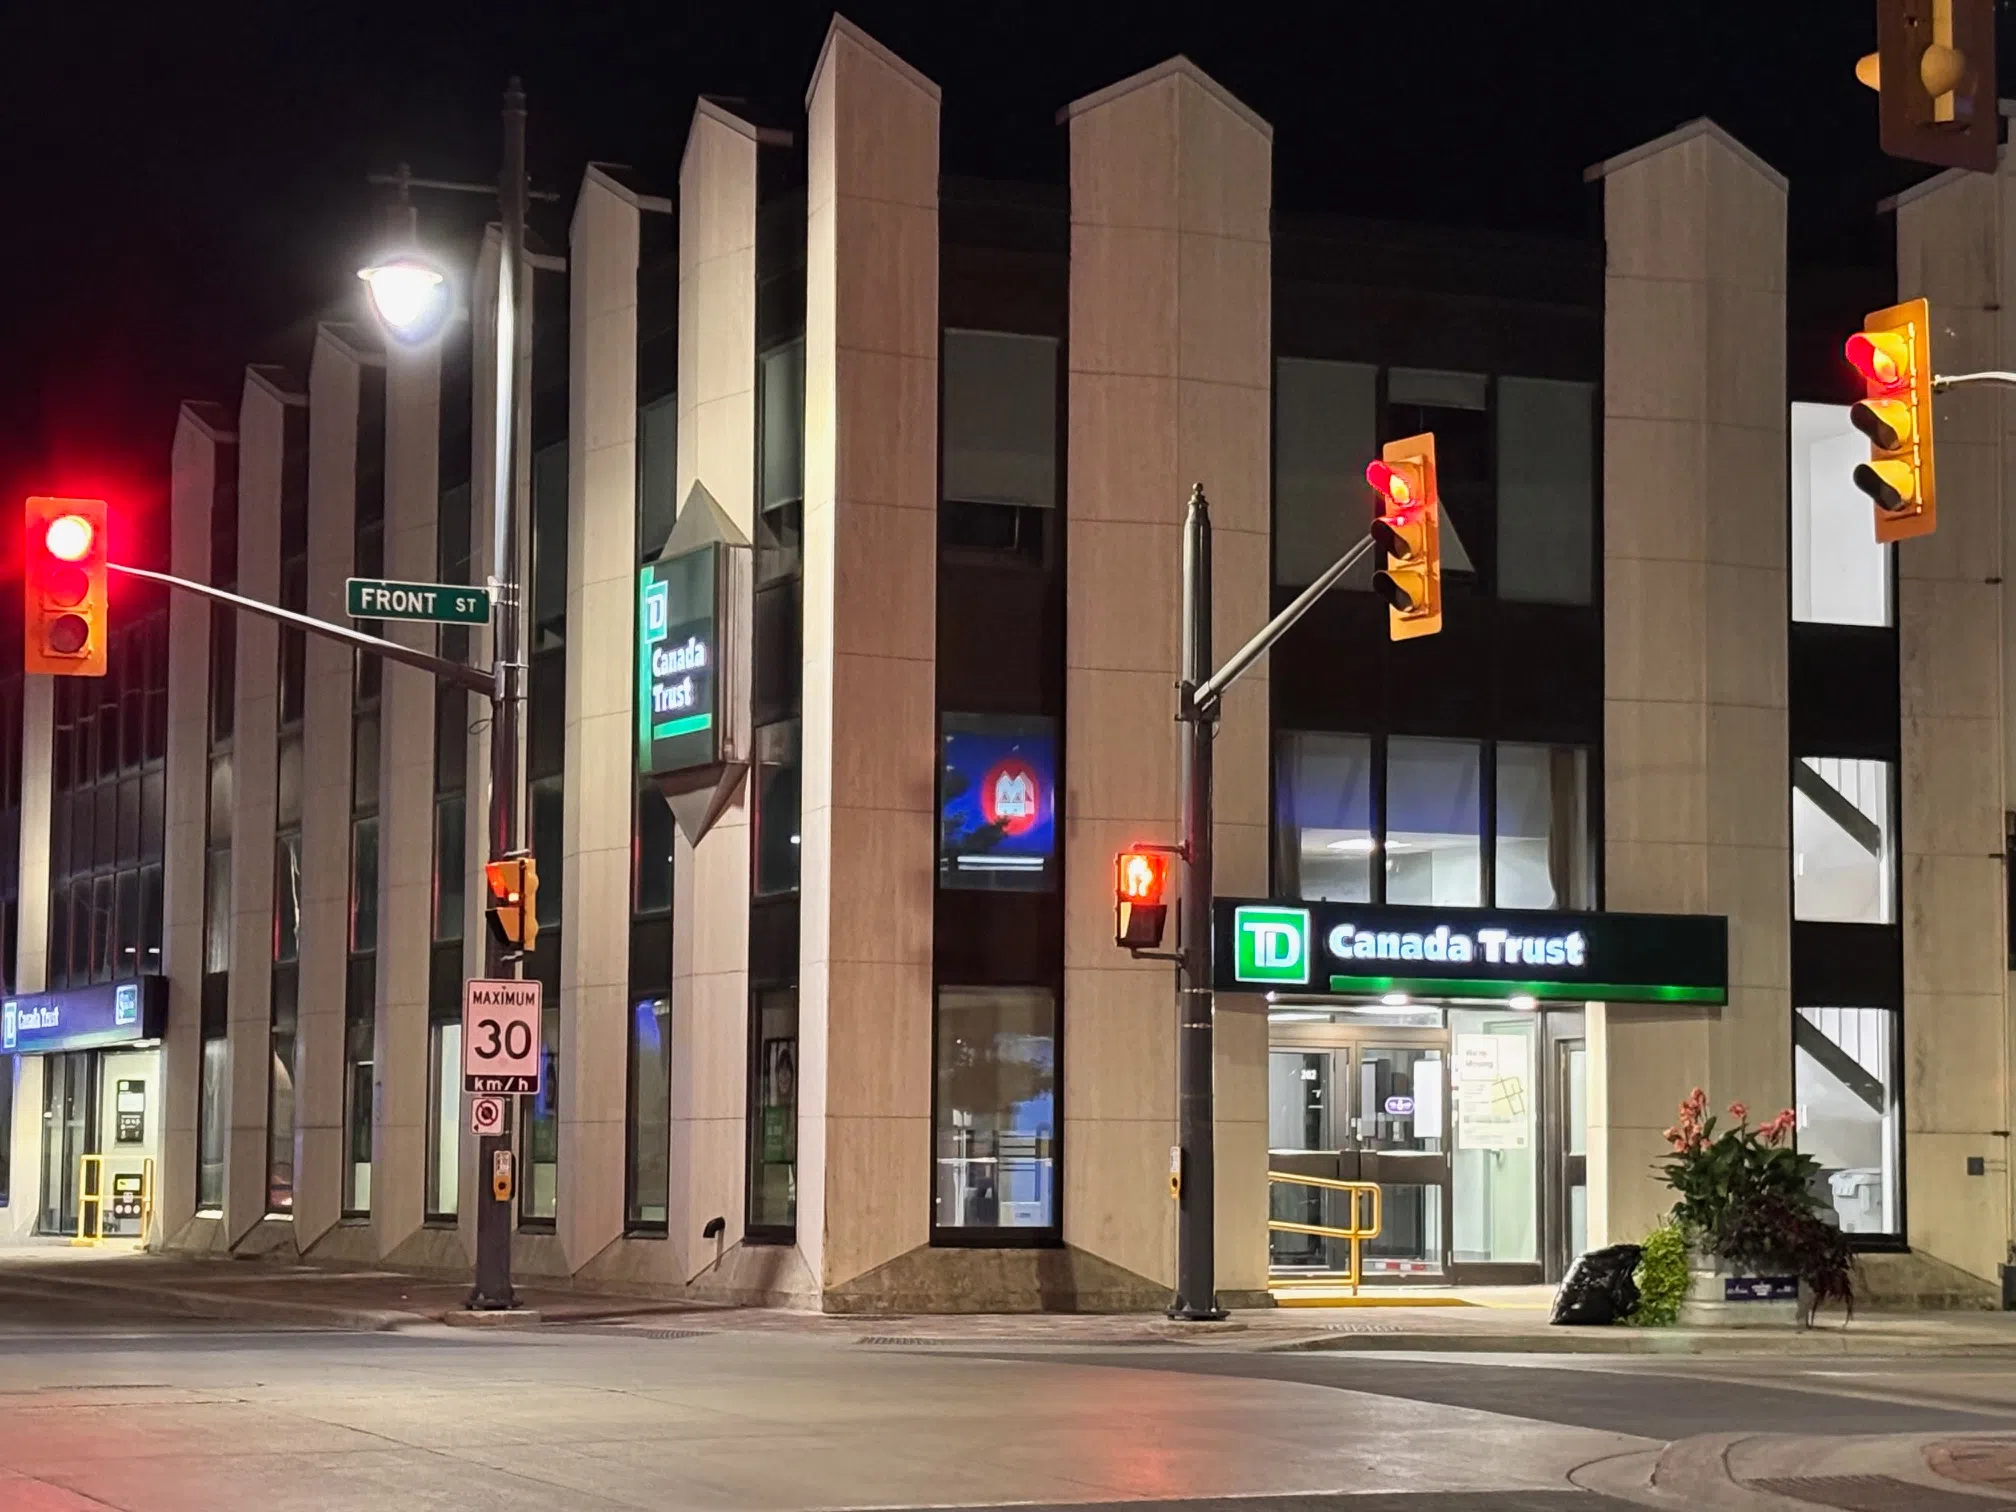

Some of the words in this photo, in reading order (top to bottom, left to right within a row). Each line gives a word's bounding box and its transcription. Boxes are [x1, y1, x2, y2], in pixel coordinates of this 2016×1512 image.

[361, 588, 437, 614] FRONT
[455, 597, 477, 613] ST
[647, 593, 665, 630] TD
[652, 636, 706, 677] Canada
[652, 676, 693, 713] Trust
[1242, 922, 1301, 968] TD
[1328, 923, 1473, 962] Canada
[1477, 929, 1586, 966] Trust
[472, 990, 536, 1007] MAXIMUM
[474, 1018, 532, 1060] 30
[473, 1076, 529, 1092] km/h
